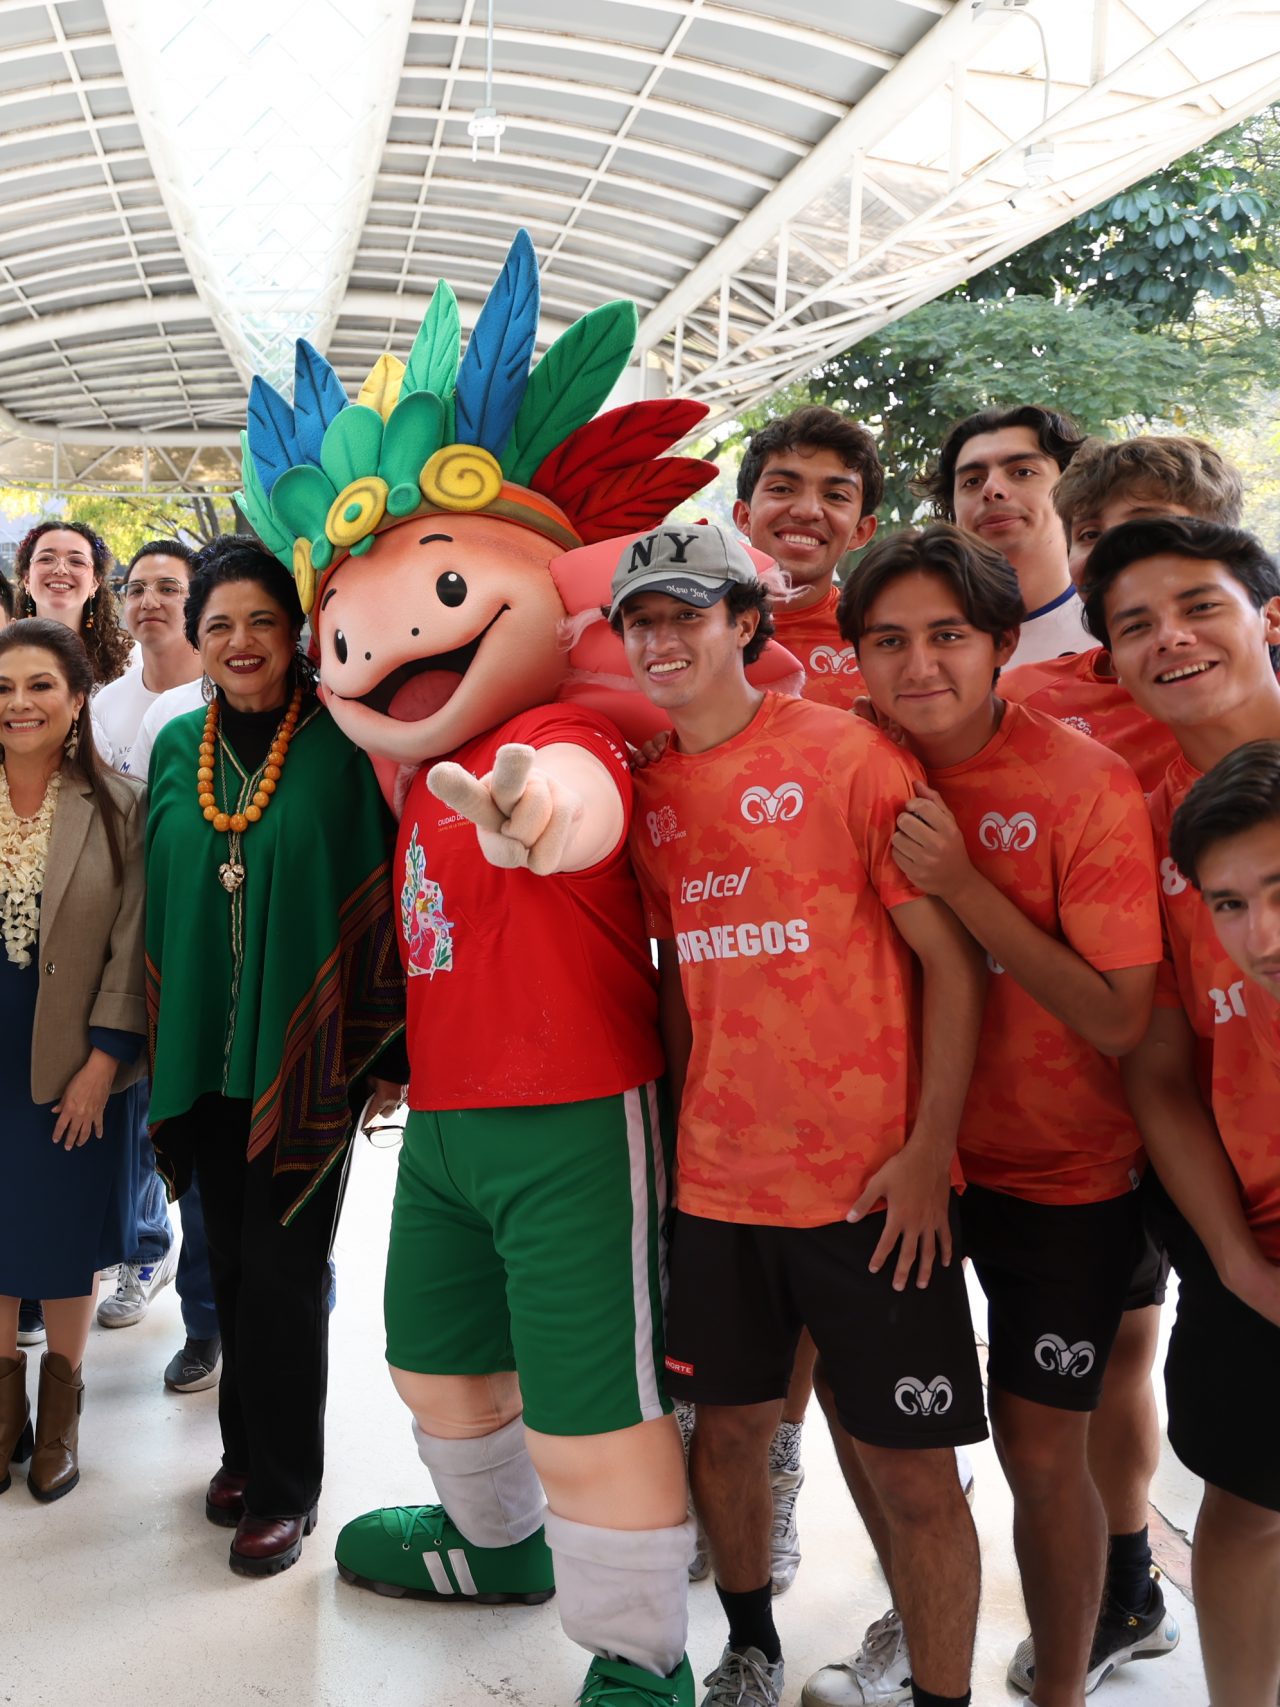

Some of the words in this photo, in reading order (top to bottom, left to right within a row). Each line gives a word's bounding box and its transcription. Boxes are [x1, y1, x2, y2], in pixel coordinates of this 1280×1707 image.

[627, 532, 699, 573] NY
[681, 866, 751, 904] telcel
[676, 918, 810, 965] ORREGOS
